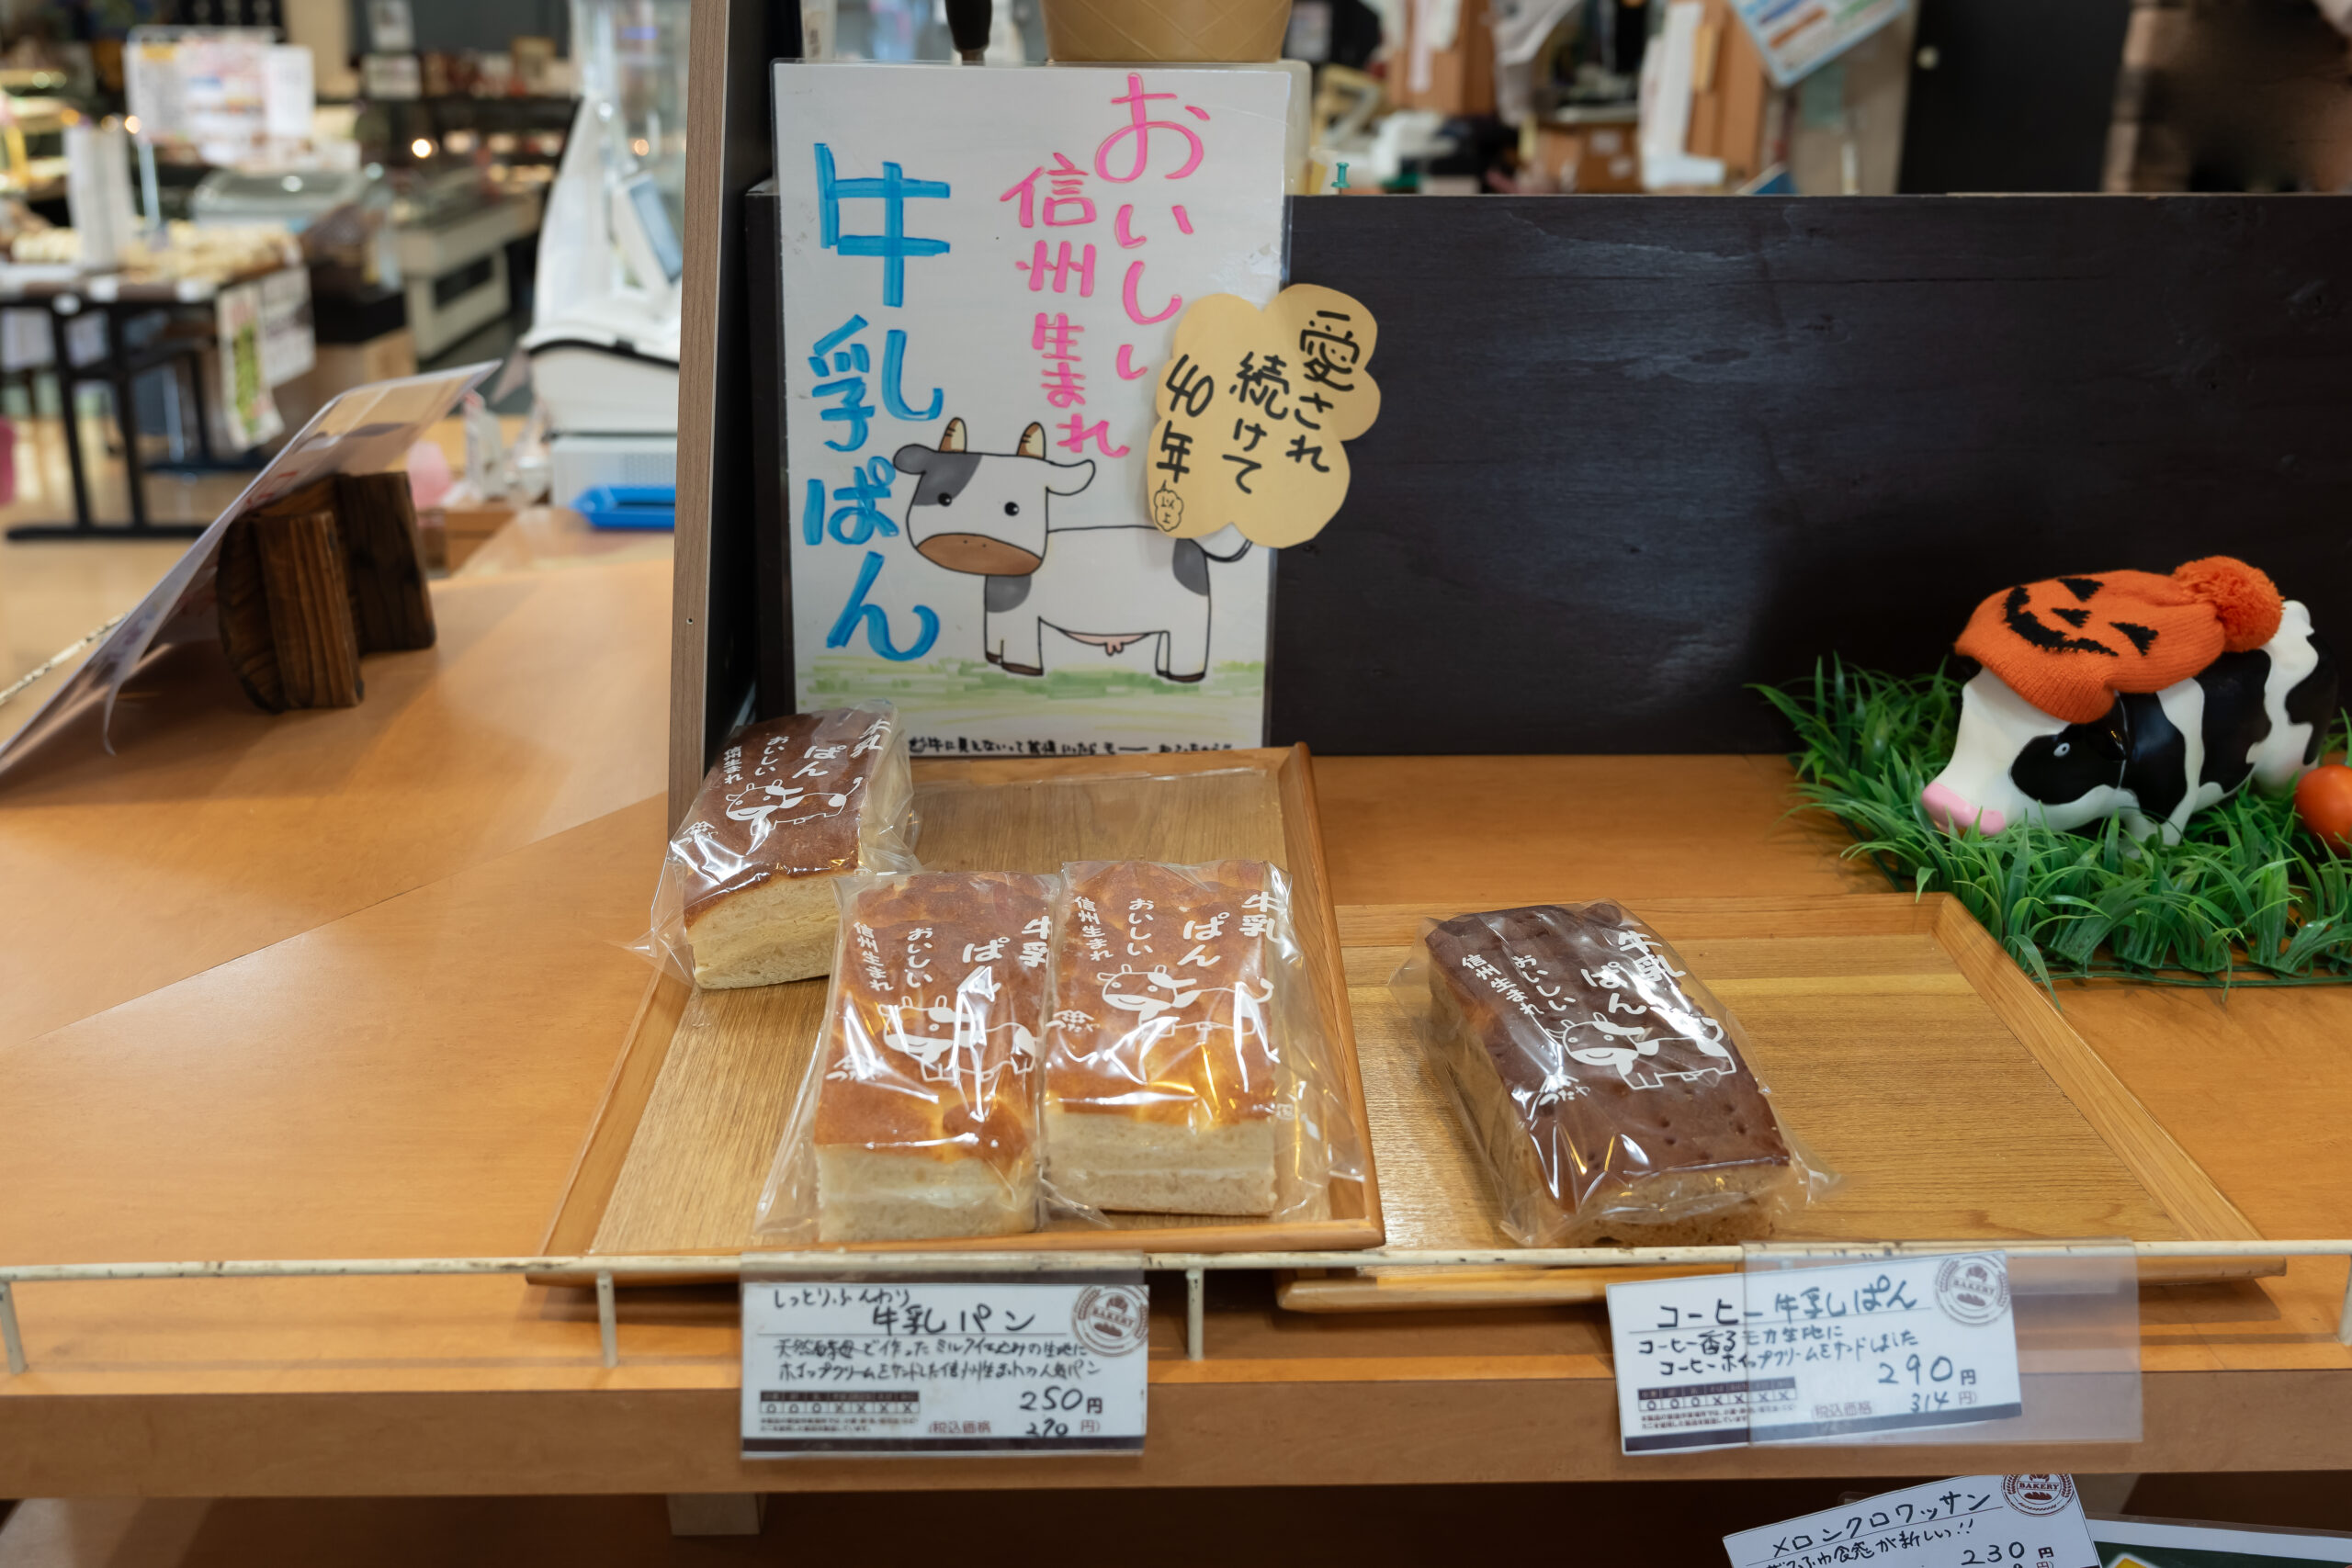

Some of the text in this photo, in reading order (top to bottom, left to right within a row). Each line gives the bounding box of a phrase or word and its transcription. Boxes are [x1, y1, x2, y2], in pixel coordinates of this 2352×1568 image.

[1000, 152, 1130, 458] 信州生まれ
[802, 142, 951, 661] 牛乳ぱん
[1156, 354, 1214, 483] 40年
[1285, 310, 1361, 473] 愛され
[1222, 351, 1290, 494] 続けて
[755, 736, 790, 776] おいしい
[792, 744, 847, 779] ぱん
[1074, 896, 1114, 962] 信州生まれ
[1126, 898, 1155, 956] おいしい
[1177, 912, 1230, 966] ぱん
[1238, 892, 1284, 943] 牛乳
[854, 922, 894, 992] 信州生まれ
[905, 927, 933, 988] おいしい
[1462, 954, 1544, 1015] 信州生まれ
[1513, 954, 1576, 1011] おいしい
[1618, 930, 1687, 983] 牛乳
[1581, 962, 1647, 1015] ぱん
[1657, 1274, 1918, 1329] コーヒー牛乳ぱん
[1952, 1278, 1996, 1296] BAKERY
[1092, 1306, 1135, 1328] BAKERY
[2018, 1482, 2060, 1491] BAKERY
[1773, 1490, 1991, 1557] メロンクロワッサン
